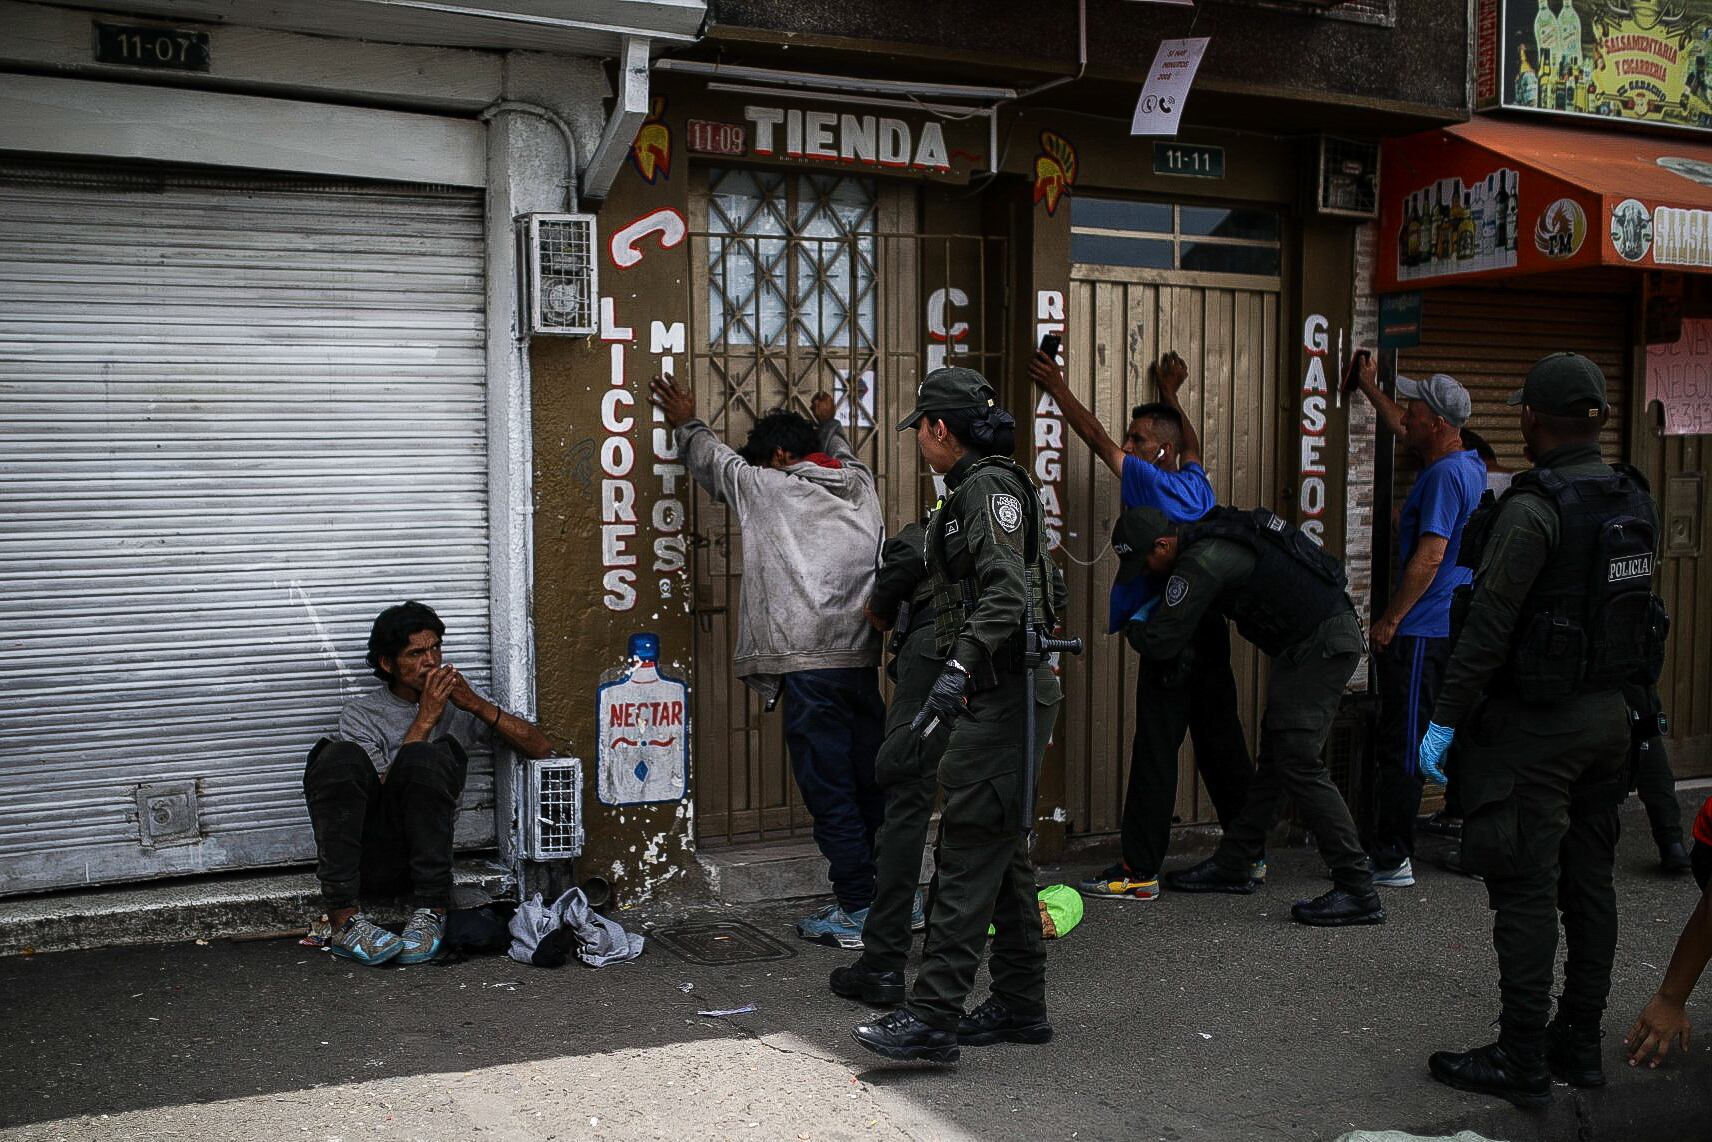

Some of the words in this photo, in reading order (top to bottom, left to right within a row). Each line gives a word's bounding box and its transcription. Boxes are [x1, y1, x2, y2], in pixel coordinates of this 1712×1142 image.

[117, 33, 191, 62] 11-07
[744, 105, 951, 172] TIENDA
[1166, 149, 1210, 172] 11-11
[600, 296, 638, 612] LICORES
[609, 700, 683, 729] NECTAR
